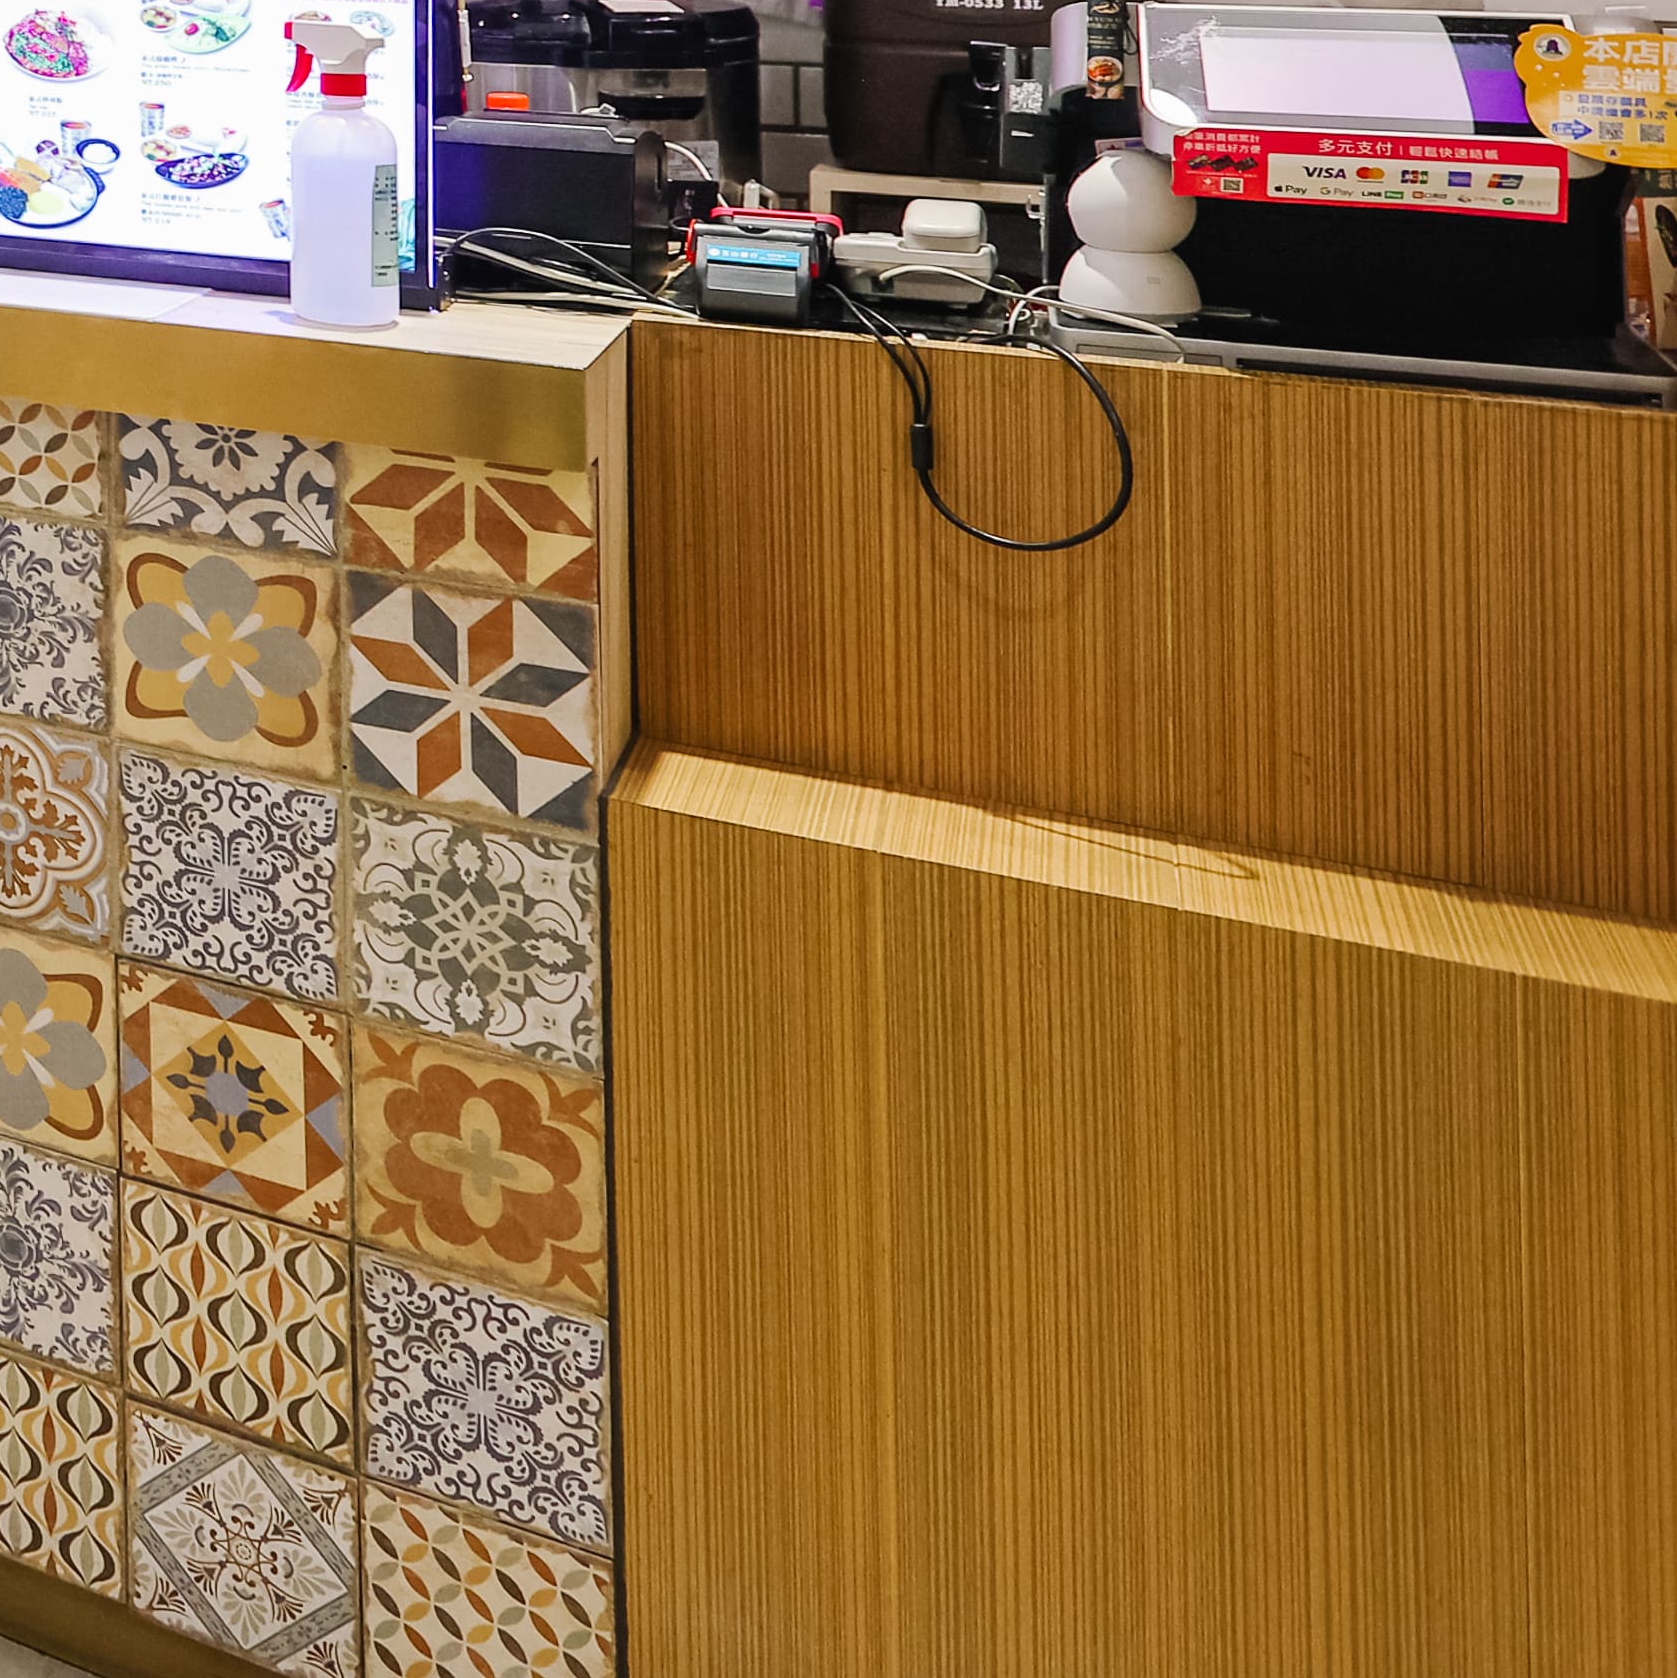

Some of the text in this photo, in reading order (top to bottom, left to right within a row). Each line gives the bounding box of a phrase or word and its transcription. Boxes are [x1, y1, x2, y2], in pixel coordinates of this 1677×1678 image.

[1318, 138, 1393, 157] 多元支付
[1302, 166, 1347, 180] VISA
[1285, 184, 1308, 196] Pay
[1361, 190, 1383, 198] LINE
